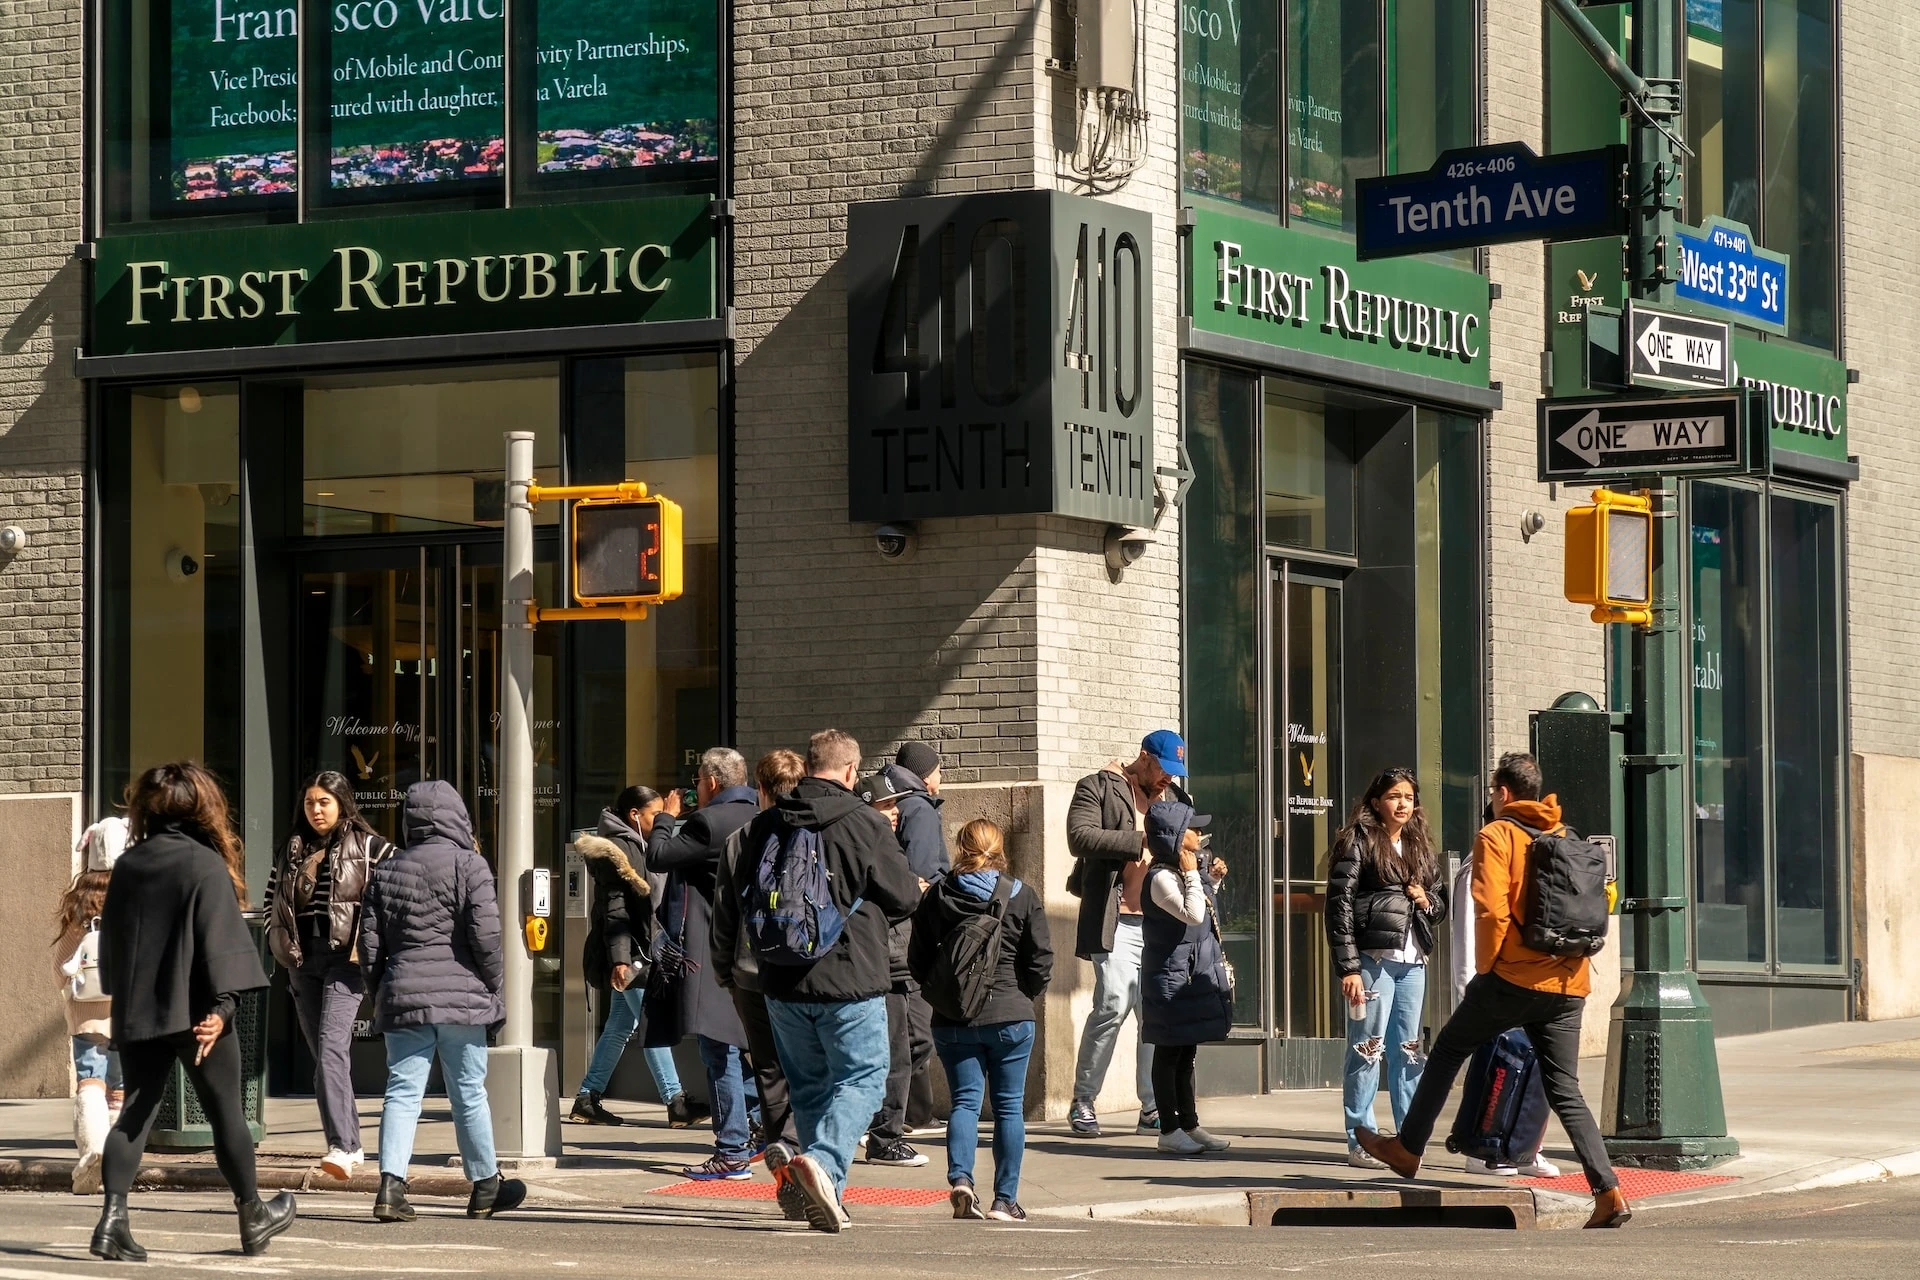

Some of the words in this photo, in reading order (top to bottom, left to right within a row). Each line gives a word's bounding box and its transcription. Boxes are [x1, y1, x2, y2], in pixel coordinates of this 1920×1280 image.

[212, 0, 399, 43] Fransco
[209, 69, 248, 91] Vice
[251, 66, 298, 89] Presi
[333, 57, 354, 81] of
[355, 53, 418, 79] Mobile
[421, 49, 454, 75] and
[576, 32, 690, 63] Partnerships,
[1188, 61, 1199, 84] of
[1199, 64, 1232, 93] Mobile
[210, 99, 297, 128] Facebook;
[376, 89, 414, 113] with
[418, 84, 498, 117] daughter,
[552, 73, 608, 99] Varela
[1210, 105, 1230, 129] with
[1296, 126, 1323, 153] Varela
[1388, 184, 1492, 234] Tenth
[1504, 181, 1576, 221] Ave
[126, 260, 308, 325] FIRST
[333, 243, 672, 313] REPUBLIC
[1217, 239, 1313, 323] FIRST
[1325, 264, 1480, 359] REPUBLIC
[1681, 247, 1724, 297] West
[1727, 261, 1758, 302] 33rd
[1761, 271, 1779, 312] St
[872, 218, 1029, 411] 410
[1064, 222, 1142, 419] 410
[1648, 332, 1673, 360] ONE
[1685, 338, 1714, 366] WAY
[1733, 359, 1842, 436] UBLIC
[1577, 424, 1627, 451] ONE
[1653, 419, 1710, 447] WAY
[871, 420, 1032, 494] TENTH
[1063, 422, 1143, 501] TENTH
[325, 715, 388, 737] Welcome
[1287, 722, 1318, 744] Welcome
[1319, 731, 1327, 745] to
[352, 791, 387, 801] PUBLIC
[390, 788, 409, 801] BAN
[477, 786, 499, 797] FIRS
[351, 1019, 371, 1032] FDI
